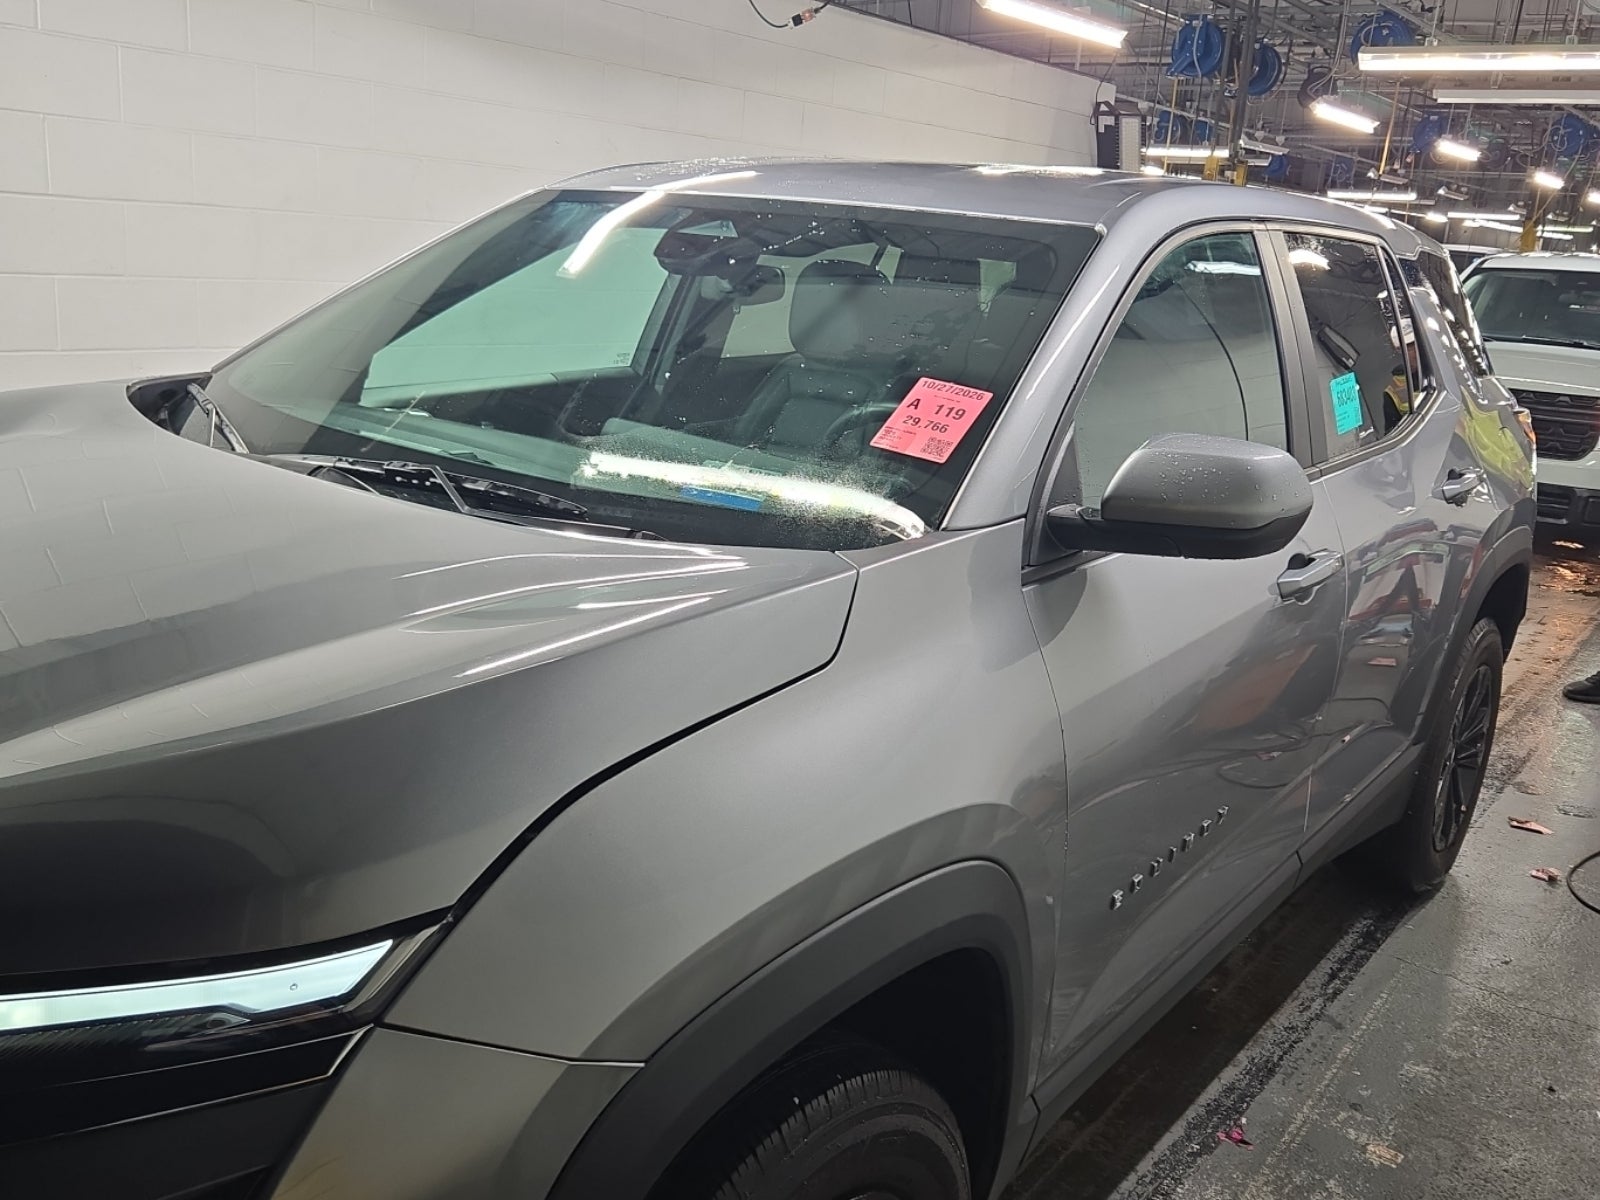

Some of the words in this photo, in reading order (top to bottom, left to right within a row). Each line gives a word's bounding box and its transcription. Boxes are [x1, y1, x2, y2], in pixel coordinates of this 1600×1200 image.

[922, 380, 985, 401] 10/27/2026
[907, 398, 921, 410] A
[934, 404, 966, 421] 119
